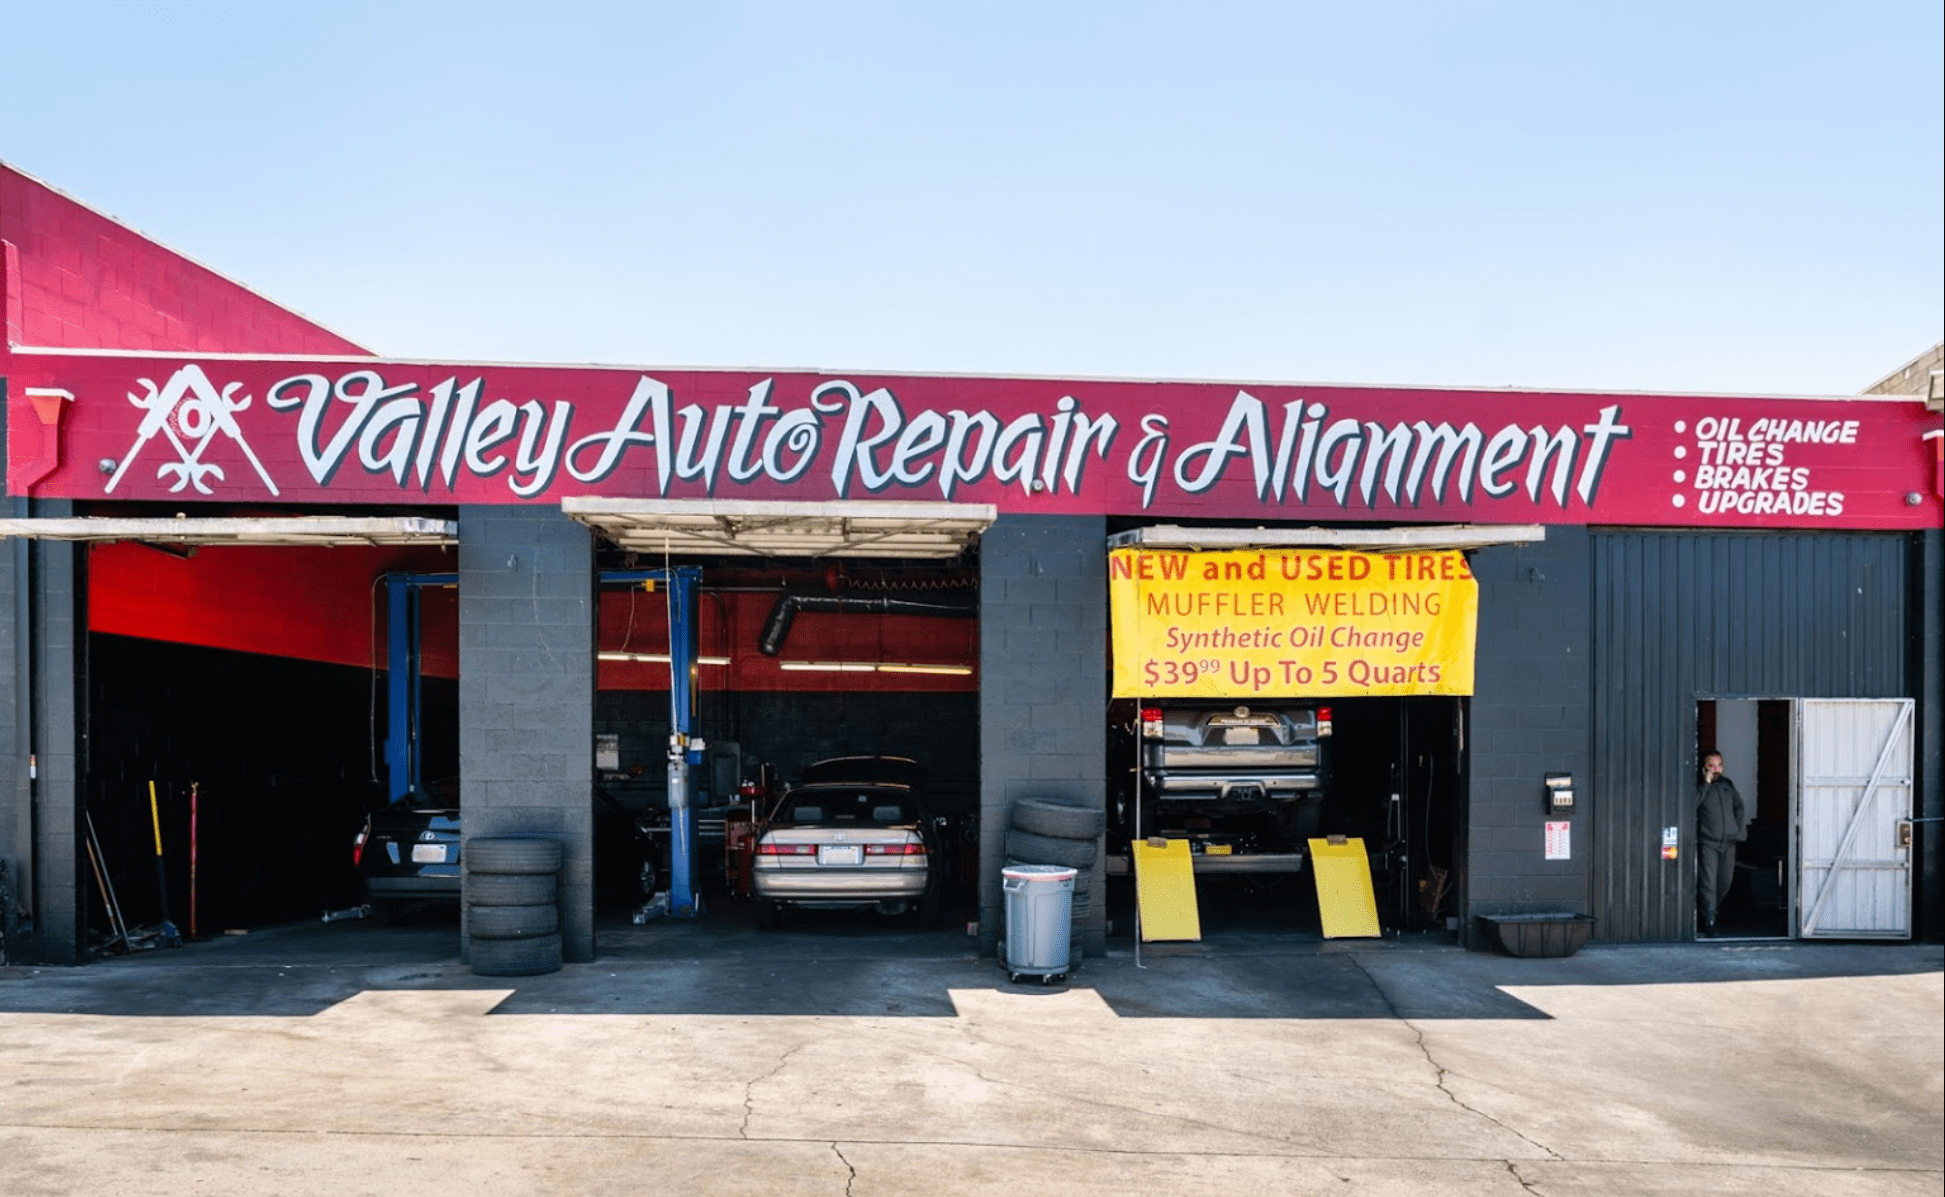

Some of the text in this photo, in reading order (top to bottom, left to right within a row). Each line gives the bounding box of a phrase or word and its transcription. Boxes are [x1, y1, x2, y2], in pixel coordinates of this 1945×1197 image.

[267, 370, 574, 498] Valley
[564, 374, 823, 499] Auto
[810, 379, 1120, 500] Repair
[1695, 416, 1860, 444] OIL CHANGE
[1697, 440, 1785, 466] TIRES
[1694, 465, 1810, 491] BRAKES
[1698, 490, 1845, 517] UPGRADES
[1111, 554, 1190, 582] NEW
[1202, 554, 1267, 582] and
[1280, 554, 1373, 582] USED
[1146, 591, 1442, 617] MUFFLER WELDING
[1165, 625, 1425, 655] Synthetic Oil Change
[1229, 660, 1272, 692] Up
[1278, 660, 1313, 686] To
[1321, 660, 1339, 686] 5
[1347, 659, 1442, 688] Quarts
